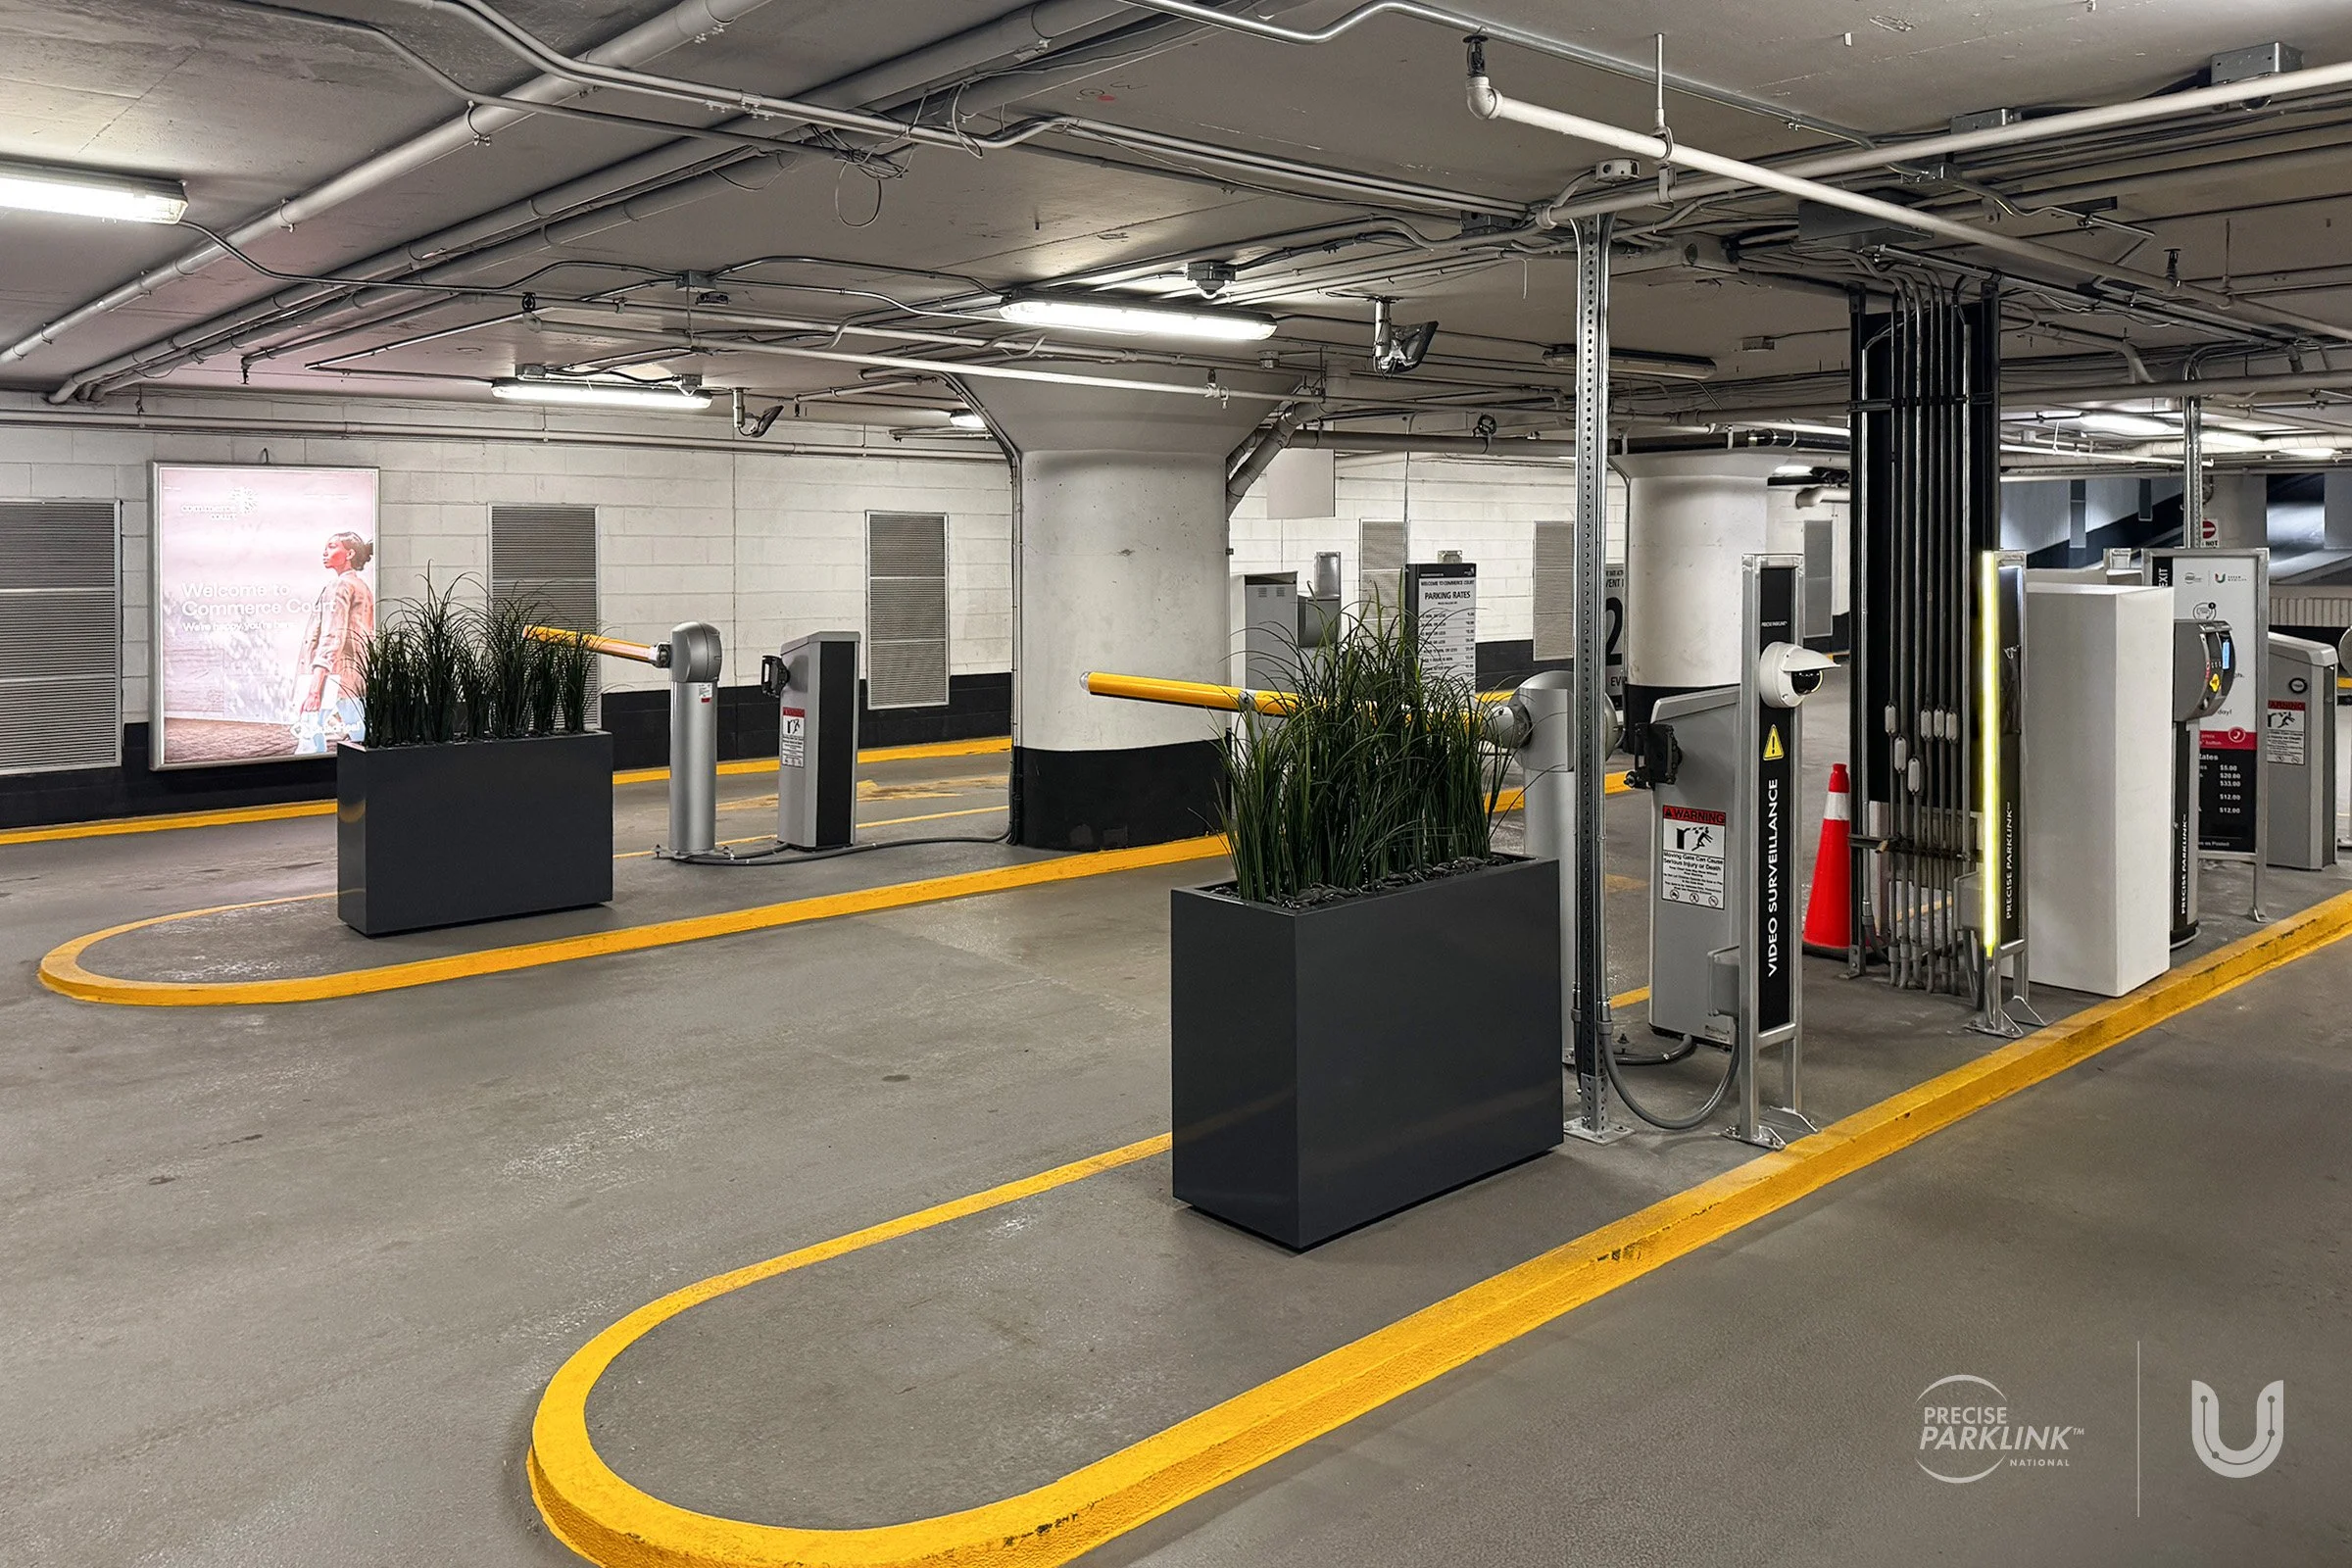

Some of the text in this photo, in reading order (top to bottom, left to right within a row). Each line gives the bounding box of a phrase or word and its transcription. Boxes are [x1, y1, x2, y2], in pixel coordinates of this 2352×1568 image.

[2158, 567, 2168, 587] EXIT
[181, 582, 291, 598] Welcome to
[1424, 590, 1471, 600] PARKING RATES
[181, 598, 337, 616] Commerce Court
[1674, 808, 1725, 824] WARNING
[1683, 860, 1698, 869] Injury
[1768, 779, 1778, 977] VIDEO SURVEILLANCE
